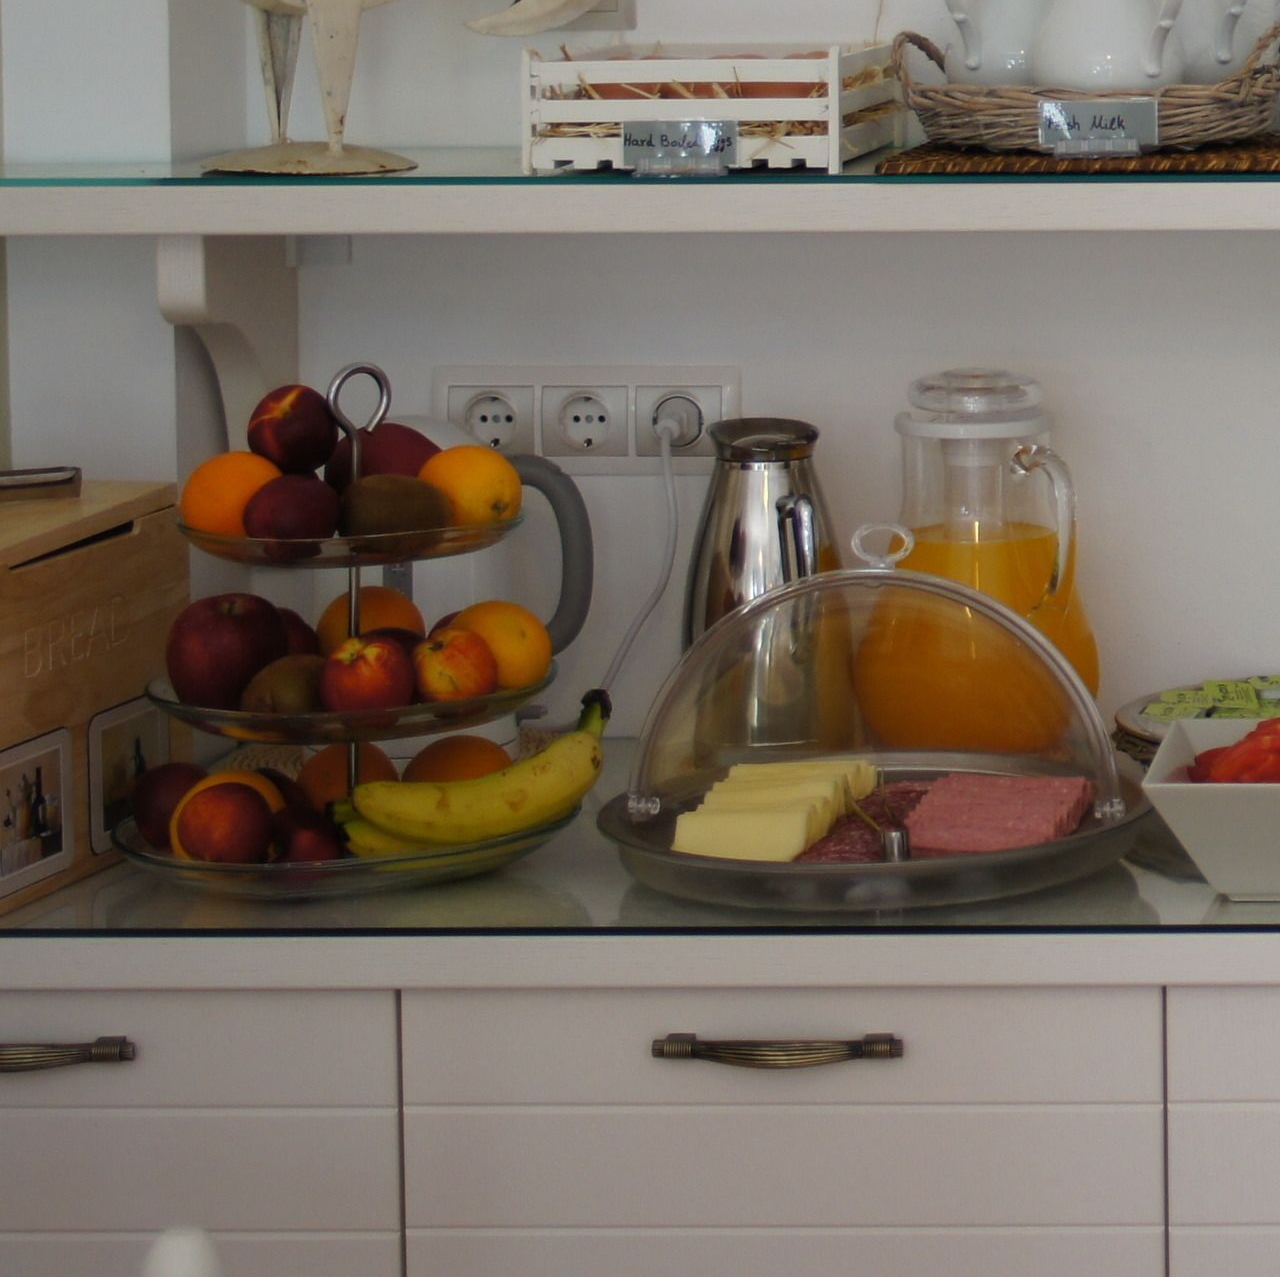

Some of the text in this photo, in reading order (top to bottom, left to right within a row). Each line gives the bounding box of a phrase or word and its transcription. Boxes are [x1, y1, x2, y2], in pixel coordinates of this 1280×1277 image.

[1089, 113, 1126, 131] Milk
[623, 131, 656, 148] Hard
[23, 595, 131, 679] BREAD
